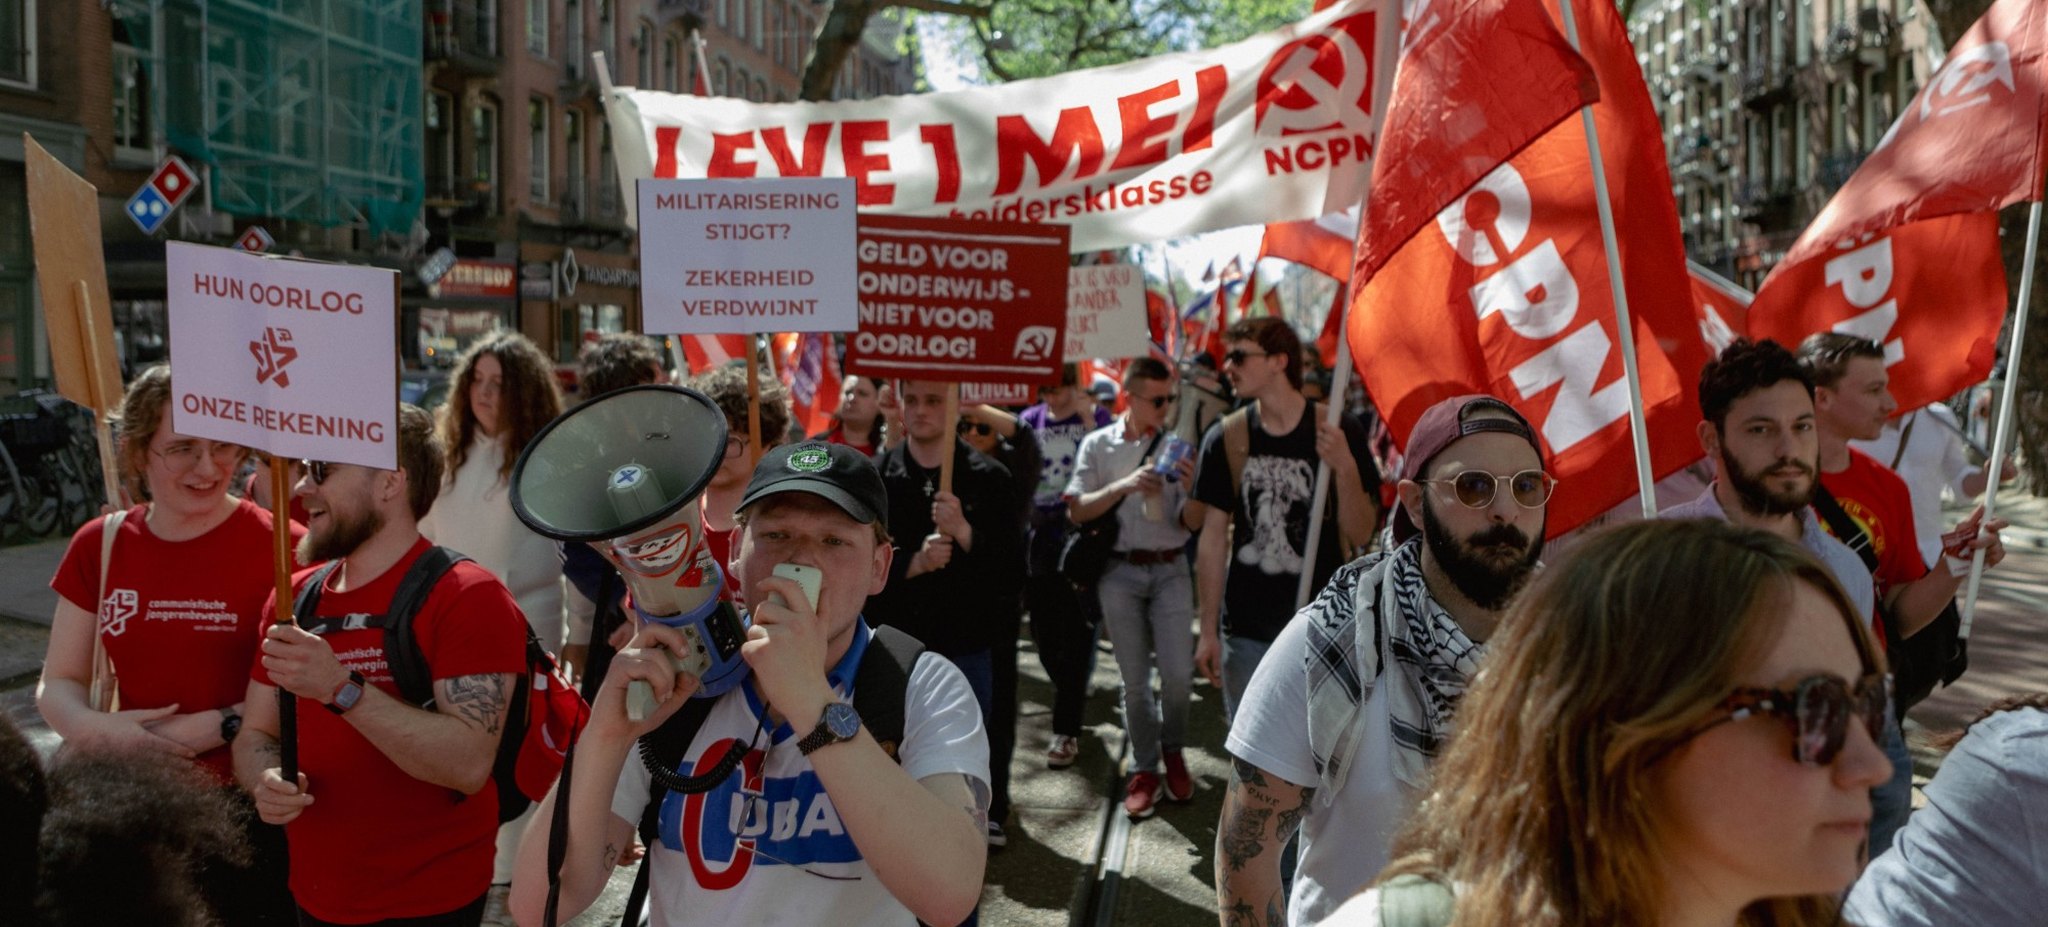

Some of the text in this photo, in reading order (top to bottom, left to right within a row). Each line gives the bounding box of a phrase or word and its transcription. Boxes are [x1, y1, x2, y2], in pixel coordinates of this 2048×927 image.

[919, 122, 962, 204] 1
[992, 64, 1228, 198] MEI
[1263, 131, 1376, 177] NCPN
[655, 192, 840, 211] MILITARISERING
[704, 223, 792, 241] STIJGT?
[858, 239, 1009, 272] GELD VOOR
[684, 268, 815, 287] ZEKERHEID
[194, 272, 364, 316] HUN OORLOG
[681, 299, 819, 317] VERDWIJNT
[858, 300, 995, 331] NIET VOOR
[854, 331, 977, 359] OORLOG!
[182, 393, 385, 444] ONZE REKENING
[681, 737, 845, 890] CUBA
